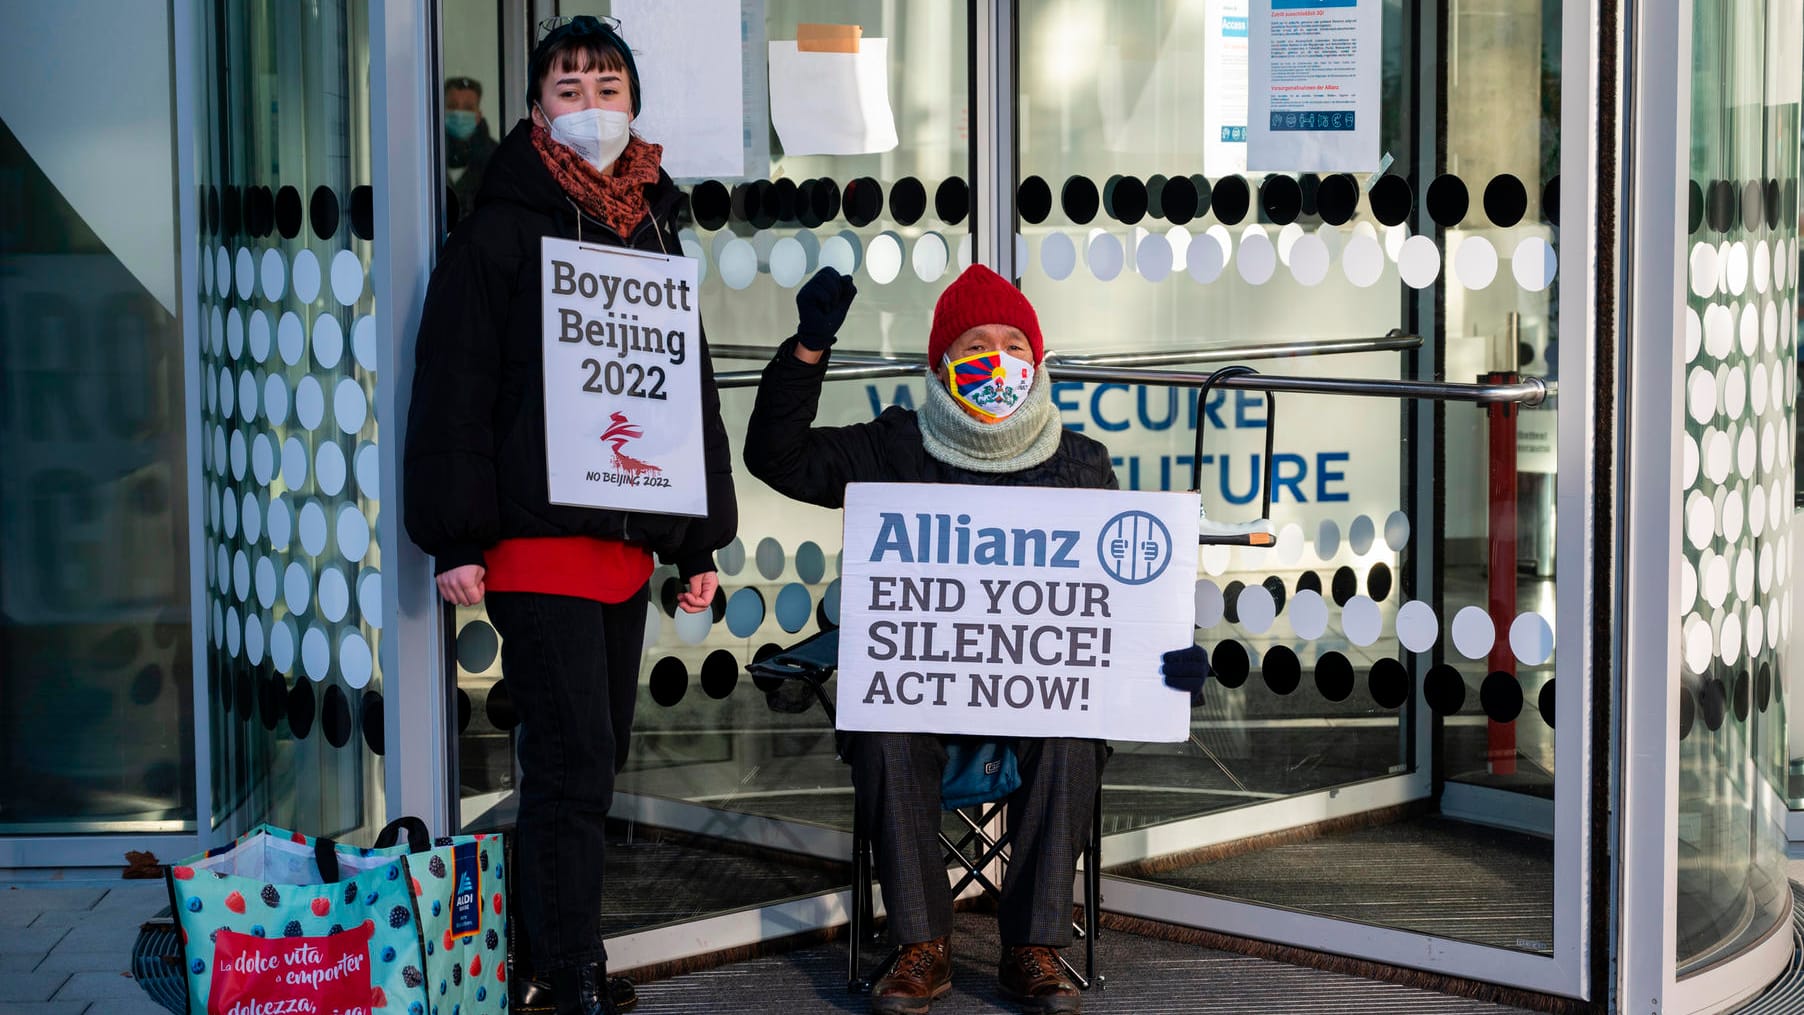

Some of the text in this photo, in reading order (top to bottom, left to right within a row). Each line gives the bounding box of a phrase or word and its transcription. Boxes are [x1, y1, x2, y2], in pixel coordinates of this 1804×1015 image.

[1222, 18, 1246, 30] Access
[551, 259, 691, 312] Boycott
[558, 307, 686, 365] Beijing
[581, 358, 668, 401] 2022
[1051, 382, 1267, 431] ECURE
[585, 471, 673, 488] NO BEIJING 2022
[1110, 452, 1350, 505] UTURE
[869, 511, 1081, 569] Allianz
[868, 576, 1112, 618] END YOUR
[867, 620, 1112, 668] SILENCE!
[862, 671, 1090, 711] ACT NOW!
[456, 893, 474, 907] ALDI
[220, 943, 324, 974] La dolce vita
[285, 952, 364, 991] emporter
